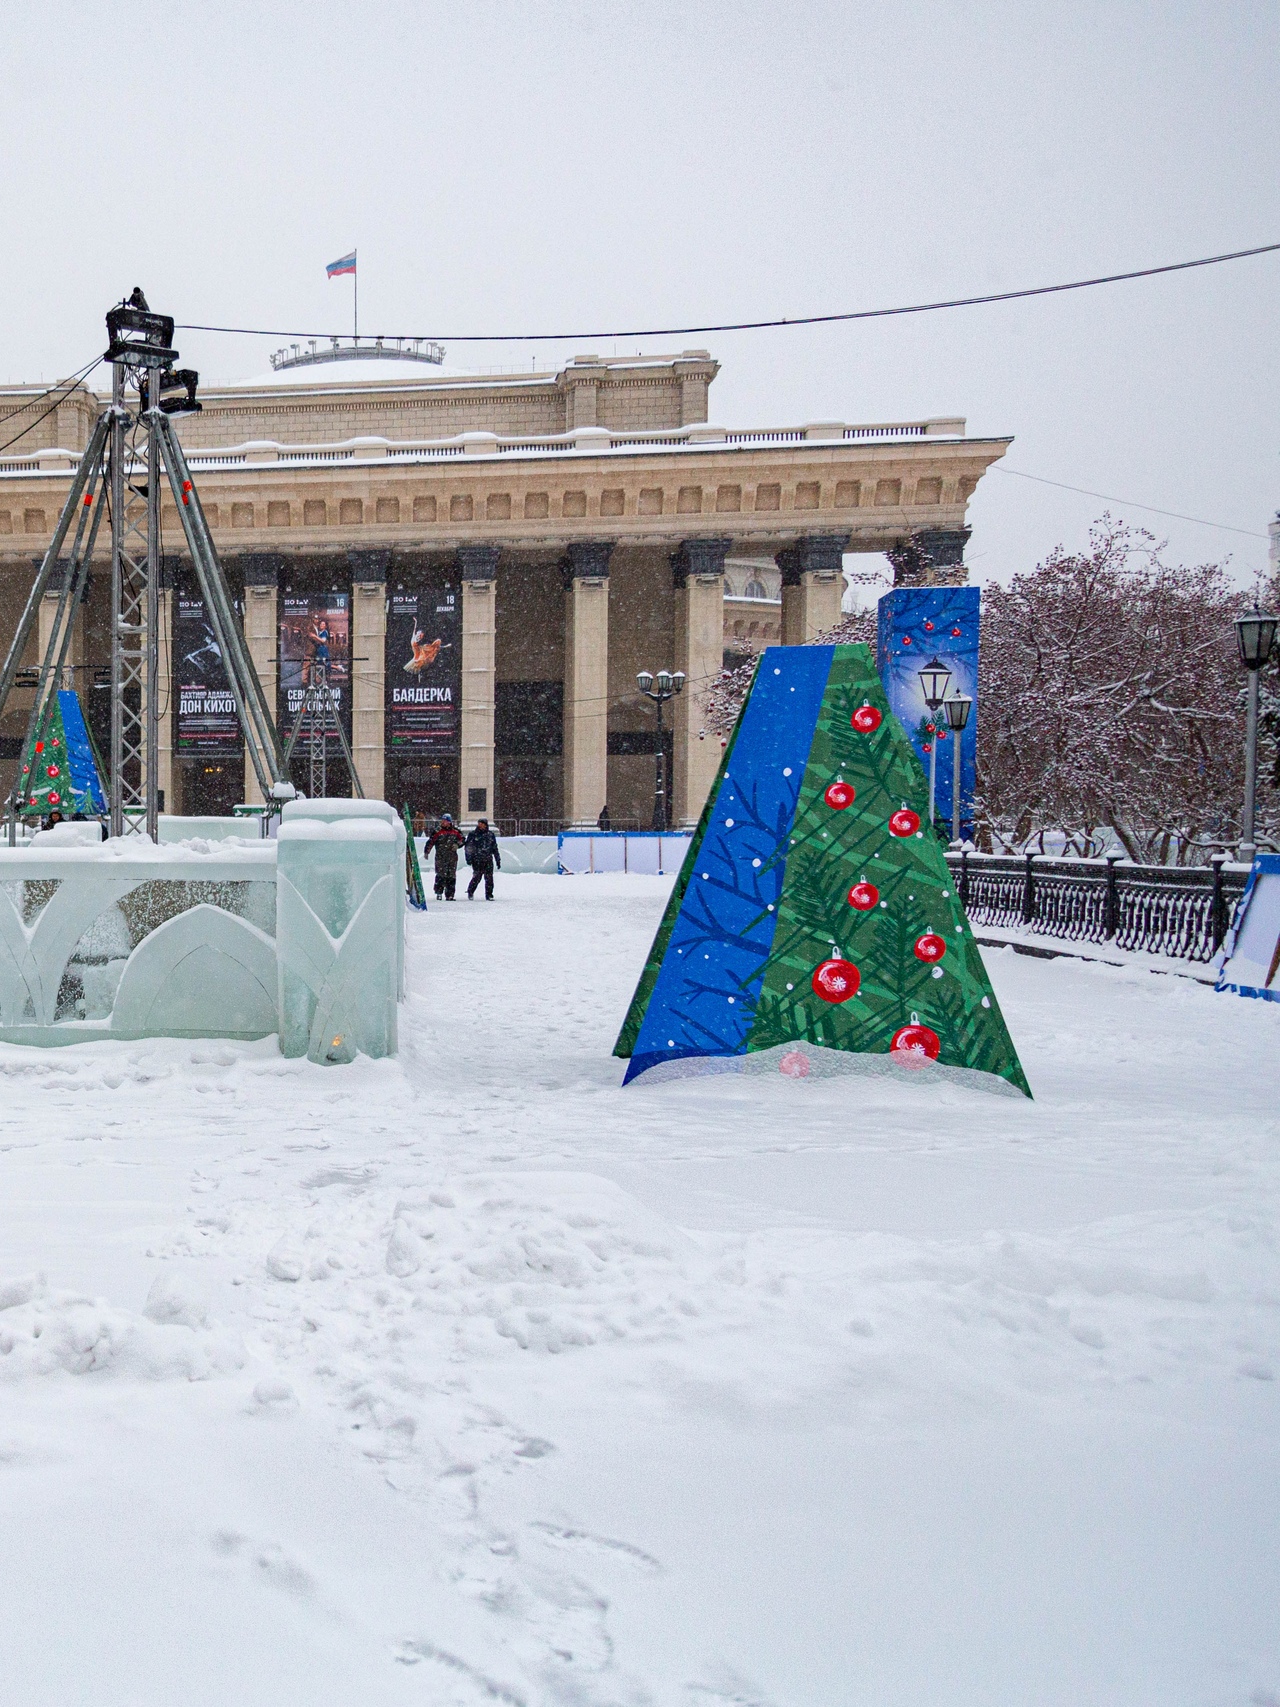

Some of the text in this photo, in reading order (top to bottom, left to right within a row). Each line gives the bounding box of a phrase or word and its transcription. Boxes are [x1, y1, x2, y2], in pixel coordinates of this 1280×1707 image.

[336, 599, 344, 607] 16
[446, 595, 455, 604] 18
[208, 691, 235, 699] АДАМЖА
[287, 687, 341, 700] СЕВЬСКИЙ
[393, 688, 451, 703] БАЯДЕРКА
[179, 700, 236, 714] ДОН КИХОТ
[288, 700, 340, 712] ЦИЛЬНК
